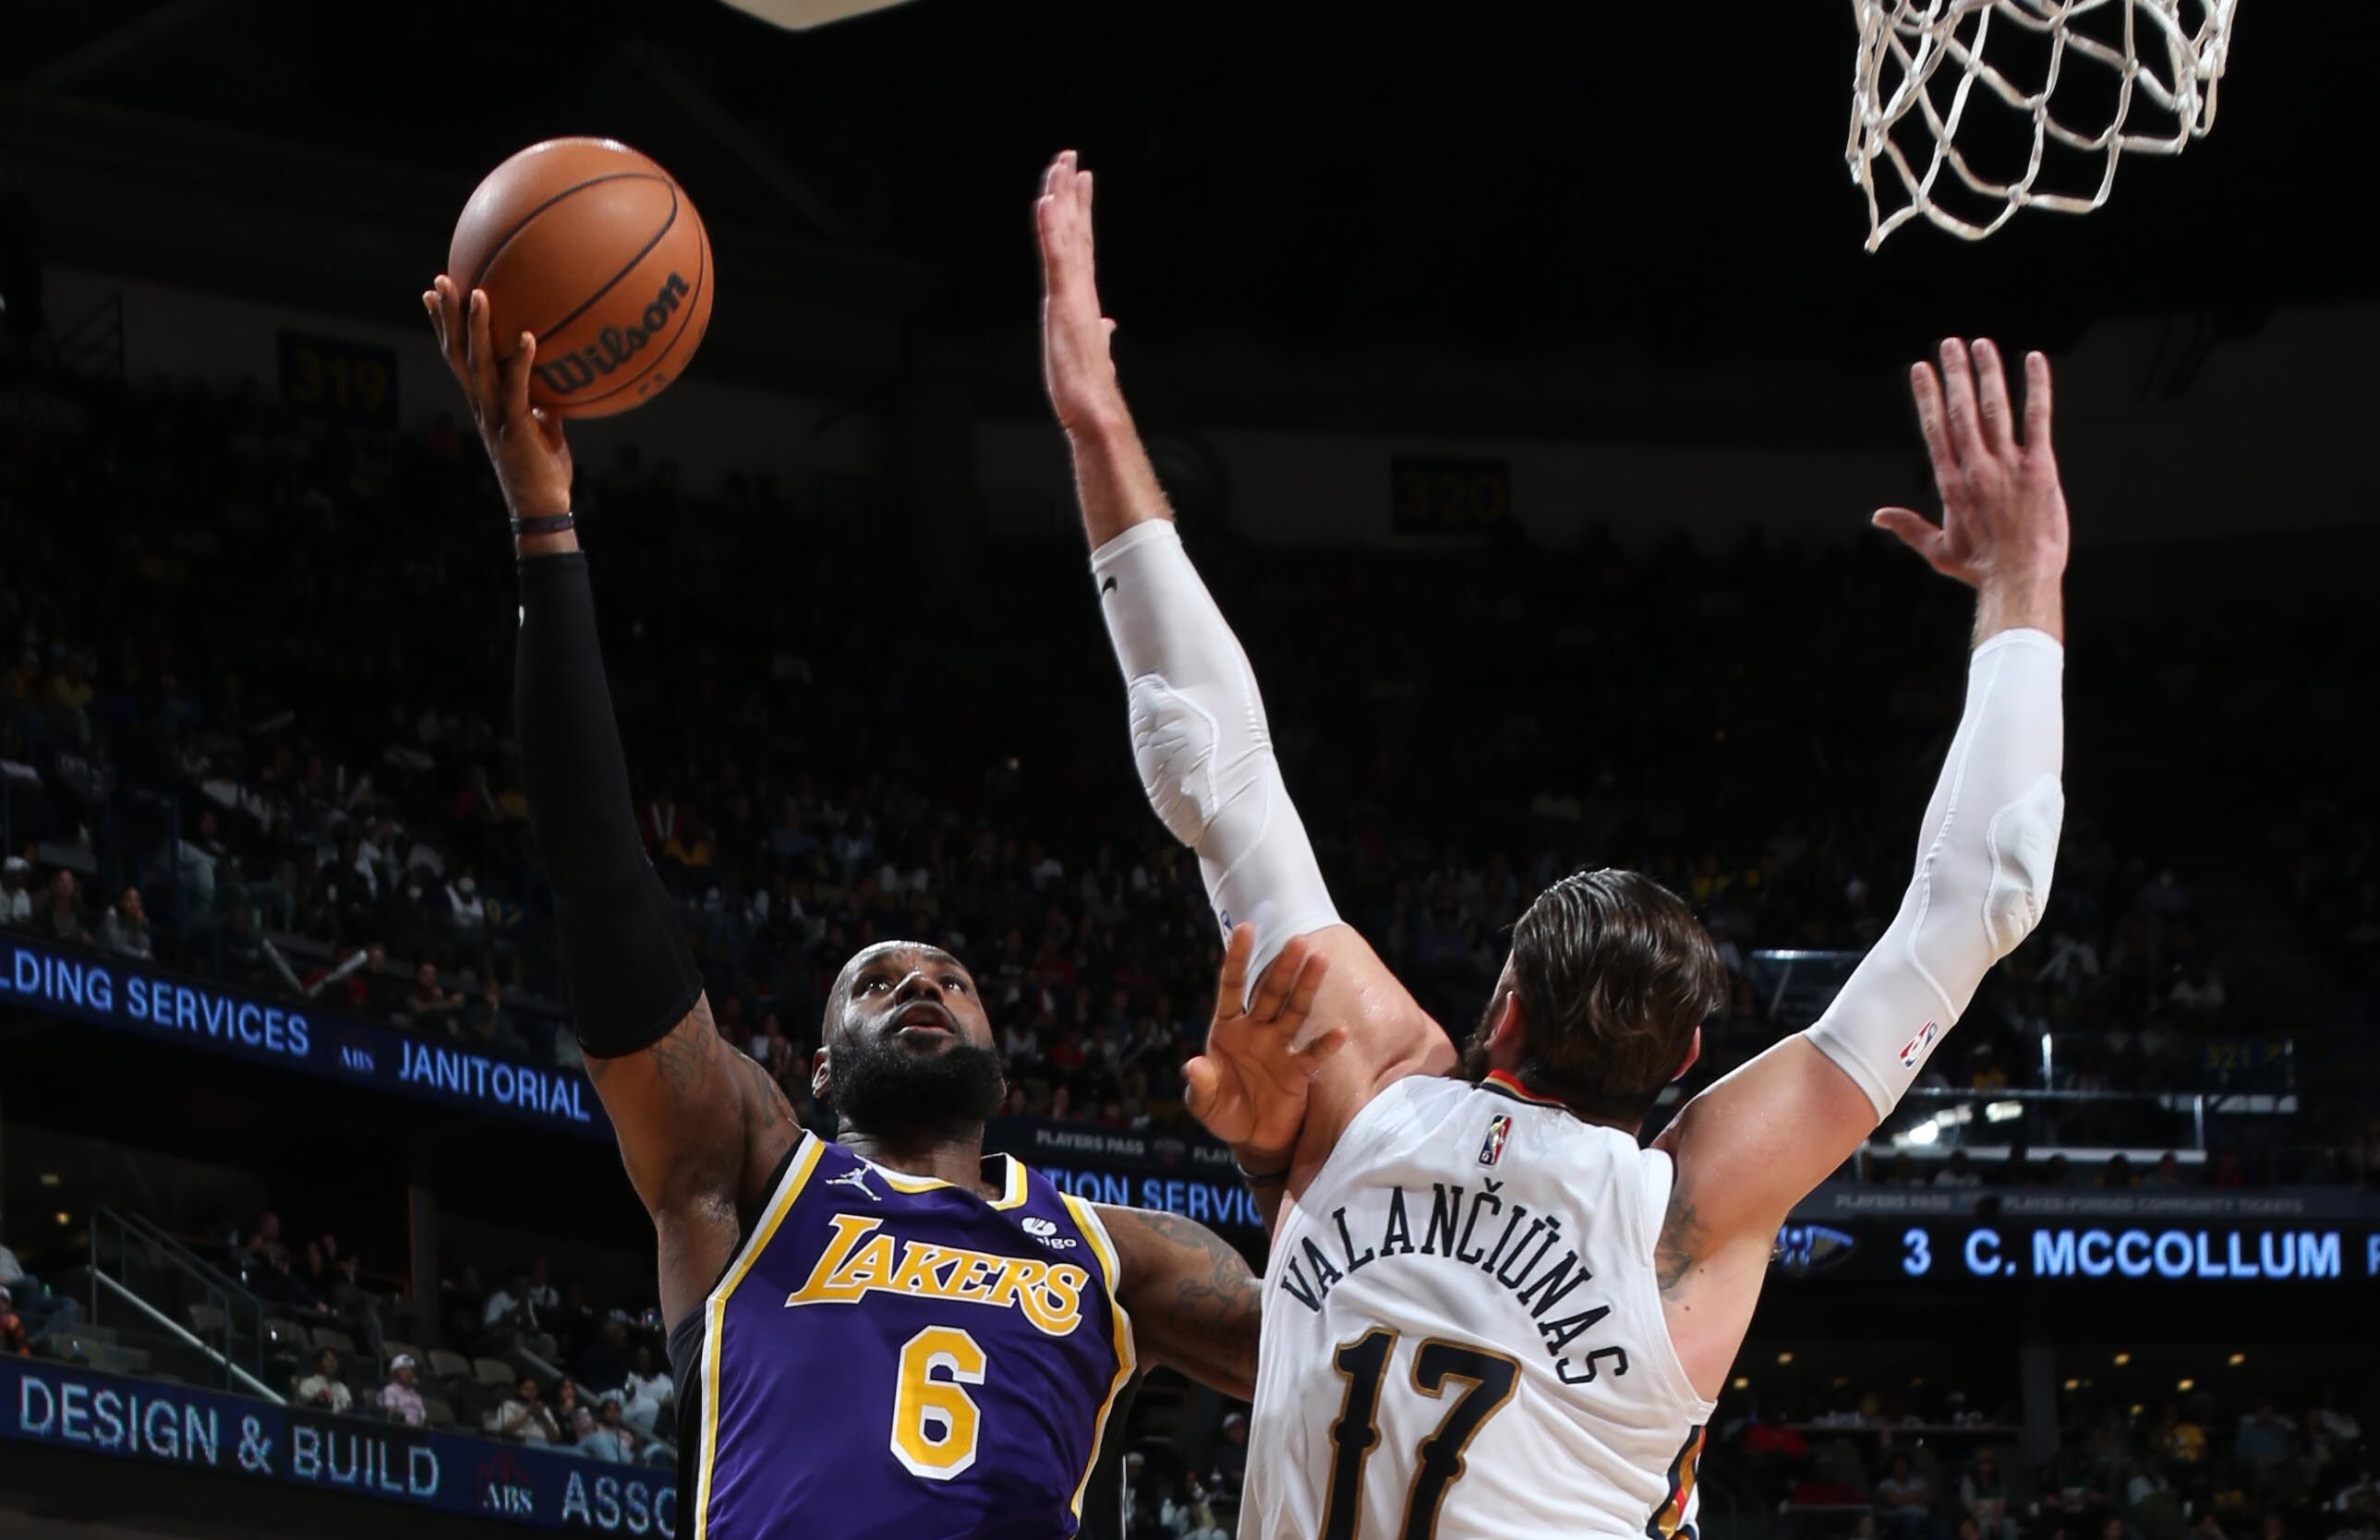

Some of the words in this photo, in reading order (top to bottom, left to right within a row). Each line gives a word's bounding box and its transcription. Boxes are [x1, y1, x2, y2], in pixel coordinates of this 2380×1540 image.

[538, 271, 690, 393] Wilson
[290, 347, 386, 414] 319
[1397, 469, 1505, 523] 320
[125, 976, 311, 1058] SERVICES
[398, 1038, 592, 1124] JANITORIAL
[1035, 1128, 1105, 1152] PLAYERS
[1105, 1137, 1145, 1155] PASS
[1193, 1146, 1236, 1164] PLAY
[1834, 1194, 1906, 1209] PLAYERS
[1910, 1195, 1951, 1209] PASS
[2003, 1195, 2133, 1210] PLAYER-FUNDED
[2137, 1197, 2233, 1212] COMMUNITY
[2239, 1197, 2304, 1214] TICKETS
[784, 1212, 1091, 1337] LAKERS
[1280, 1177, 1629, 1385] VALANČIŪNAS
[1902, 1226, 1932, 1278] 3
[1963, 1225, 2017, 1278] C.
[2032, 1228, 2342, 1280] MCCOLLUM
[18, 1374, 218, 1466] DESIGN
[236, 1414, 273, 1475] &
[293, 1424, 440, 1499] BUILD
[889, 1324, 987, 1481] 6
[1319, 1326, 1522, 1540] 17
[482, 1482, 536, 1516] ABS
